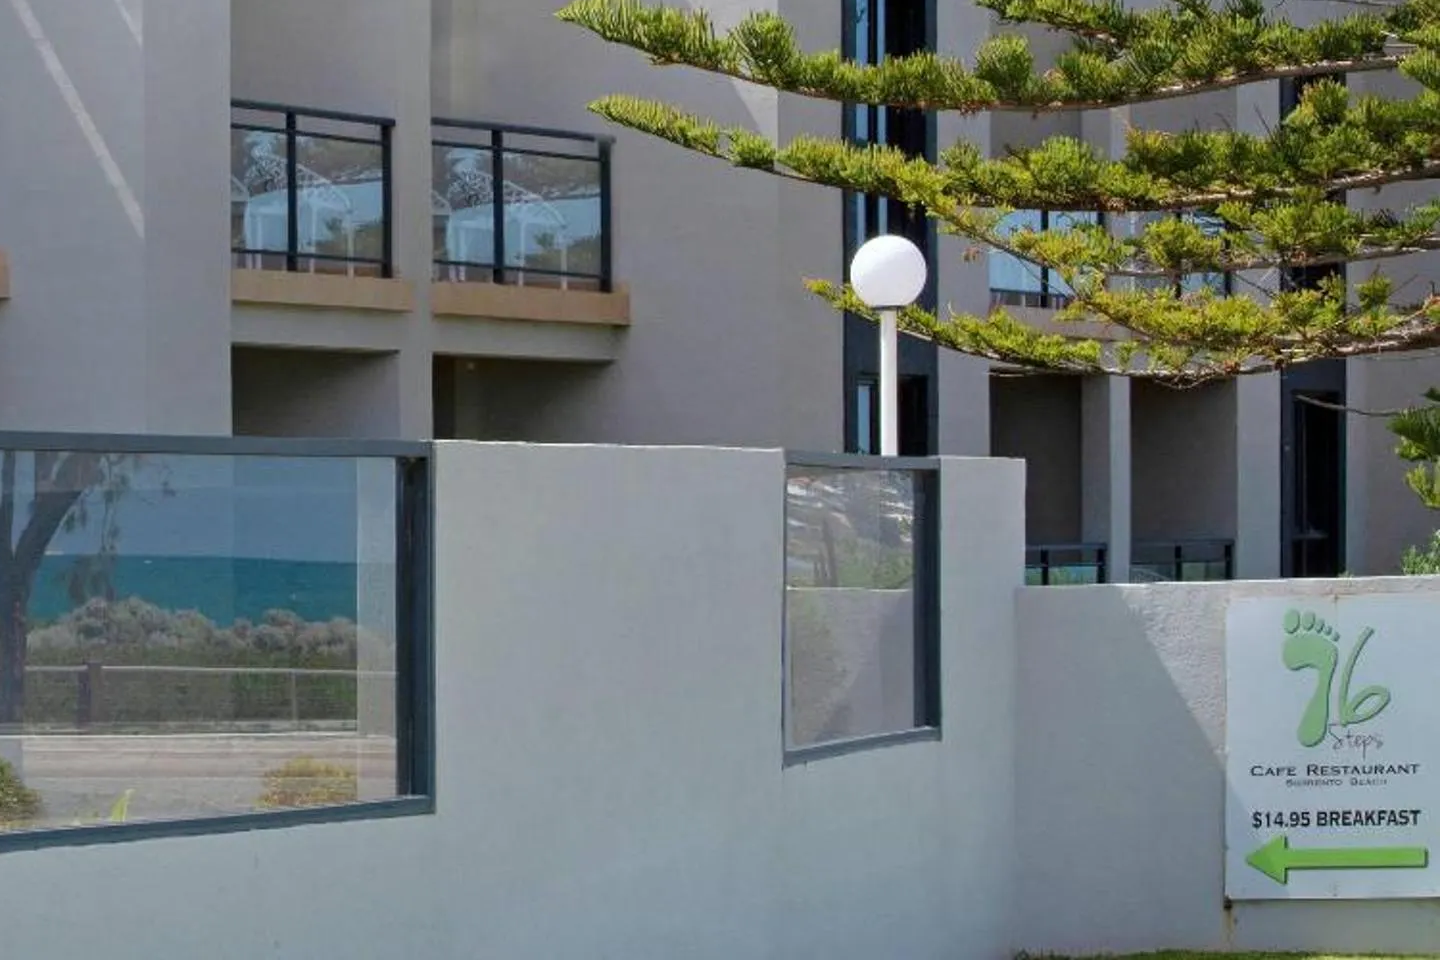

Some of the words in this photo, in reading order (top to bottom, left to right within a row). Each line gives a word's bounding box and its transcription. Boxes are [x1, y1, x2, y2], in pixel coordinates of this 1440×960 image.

[1250, 765, 1297, 777] CAFE
[1306, 763, 1421, 777] RESTAURANT
[1251, 811, 1311, 829] $14.95
[1316, 809, 1422, 827] BREAKFAST
